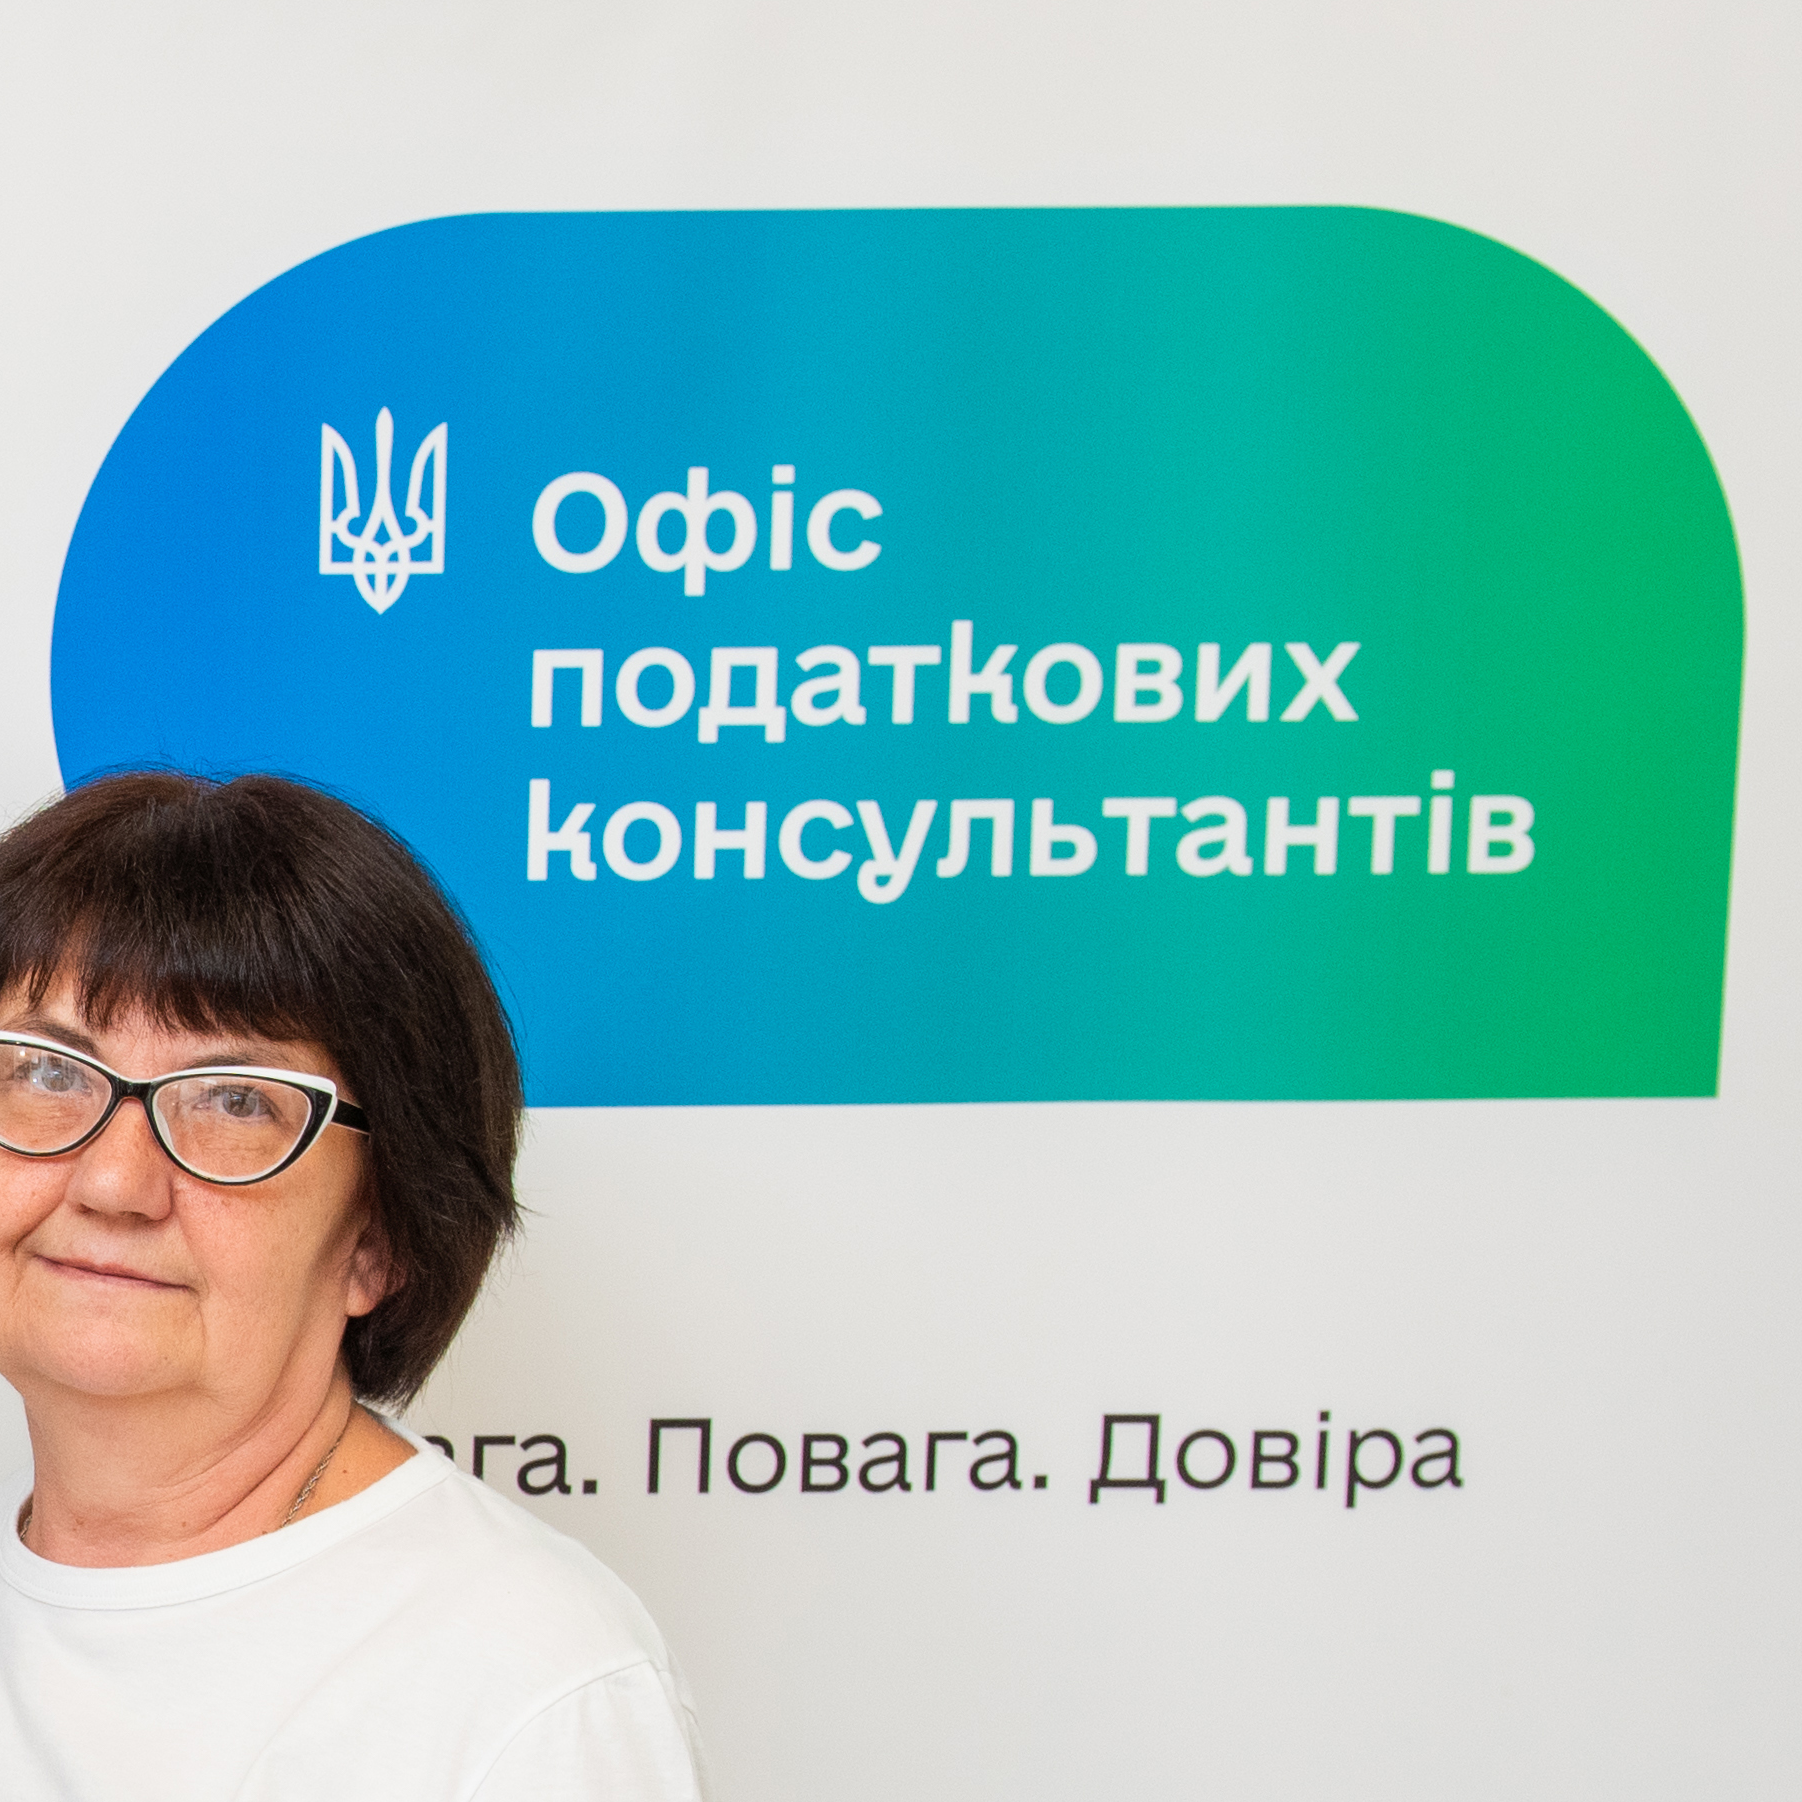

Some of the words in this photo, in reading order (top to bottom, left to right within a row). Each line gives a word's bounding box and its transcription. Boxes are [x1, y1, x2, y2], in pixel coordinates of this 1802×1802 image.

[531, 464, 884, 597] Офіс
[530, 619, 1361, 744] податкових
[525, 768, 1536, 906] консультантів
[647, 1417, 1049, 1495] Повага.
[1088, 1410, 1463, 1509] Довіра
